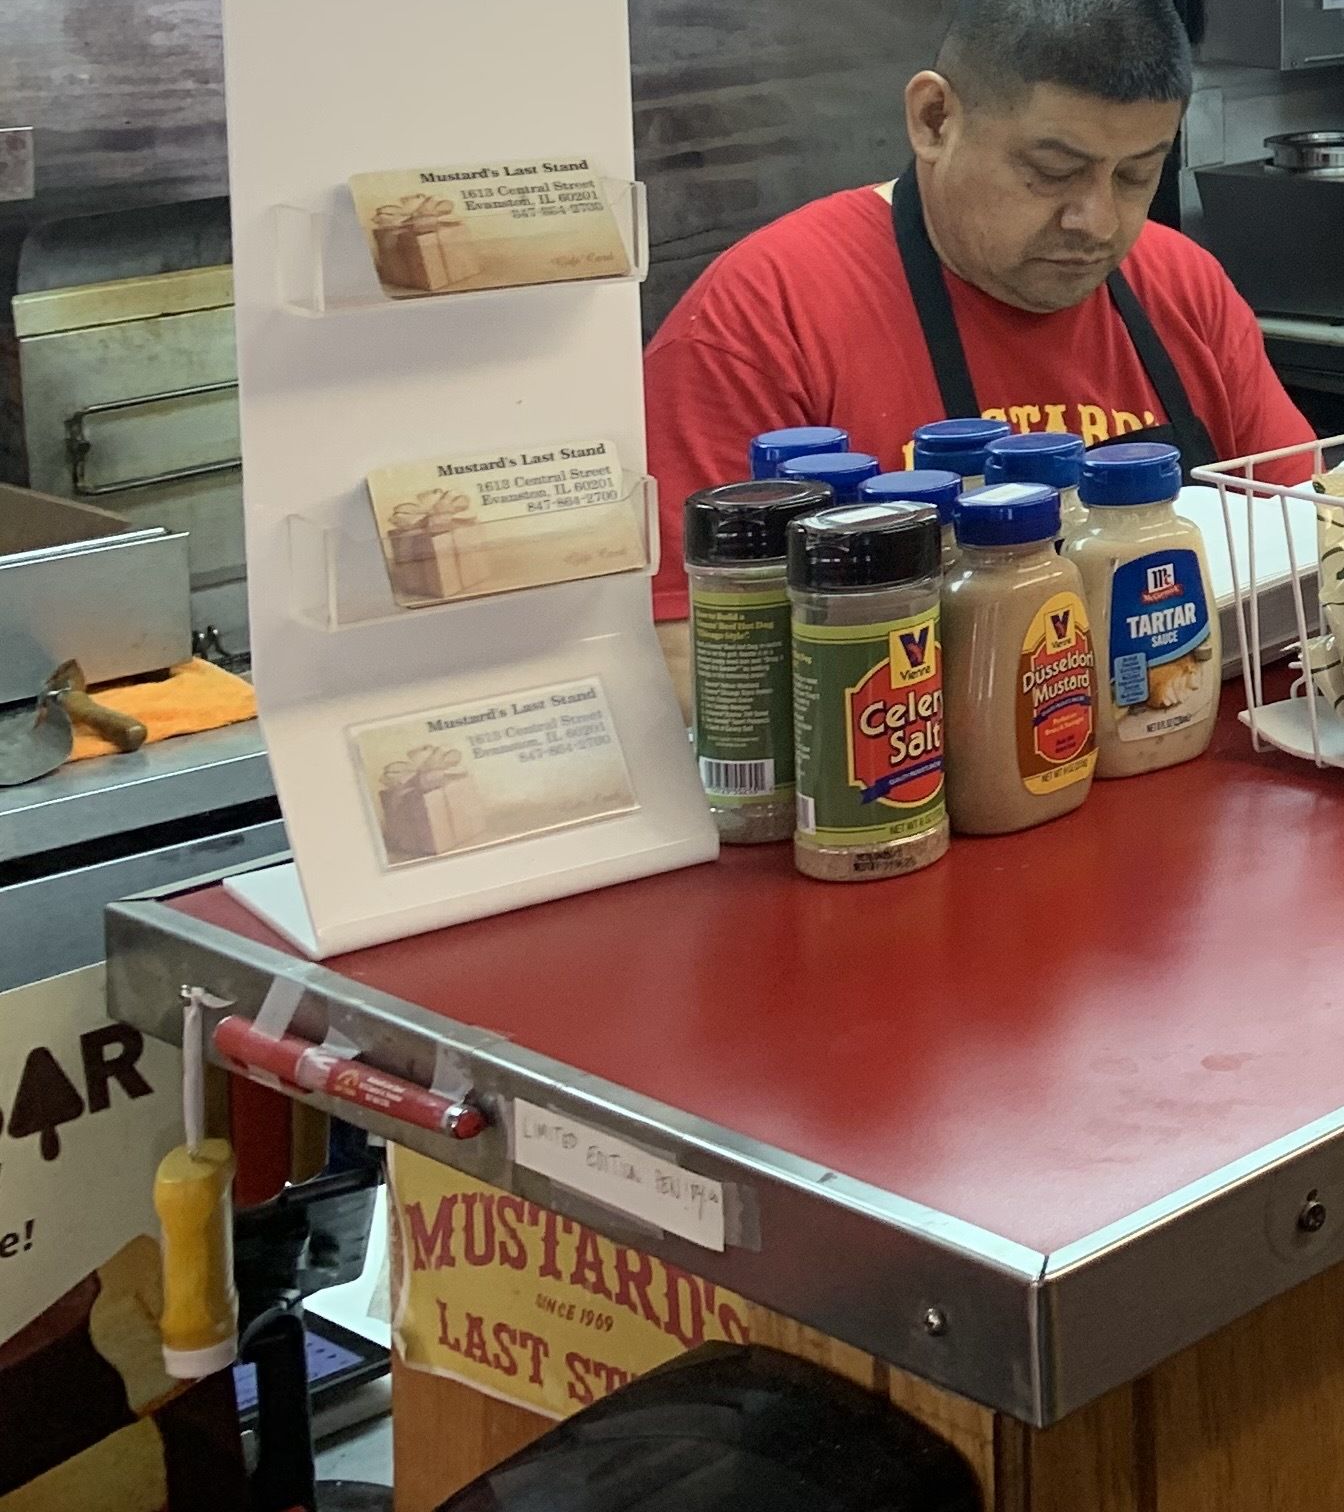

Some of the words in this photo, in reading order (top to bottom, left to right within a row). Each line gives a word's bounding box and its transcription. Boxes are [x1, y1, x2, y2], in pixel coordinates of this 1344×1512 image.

[420, 167, 499, 184] Mustard's
[503, 164, 538, 176] Last
[542, 159, 589, 173] Stand
[497, 182, 550, 196] Central
[553, 179, 596, 191] Street
[437, 456, 517, 477] Mustard's
[520, 450, 555, 466] Last
[560, 443, 606, 460] Stand
[514, 470, 567, 487] Central
[570, 465, 612, 479] Street
[1126, 601, 1197, 640] TARTAR
[1151, 629, 1179, 649] SAUCE
[900, 664, 932, 681] Vienna
[1033, 669, 1090, 709] Mustard
[426, 707, 508, 733] Mustard's
[511, 699, 545, 716] Last
[550, 687, 597, 707] Stand
[889, 720, 941, 765] Salt
[535, 1293, 577, 1322] SINCE
[436, 1297, 550, 1389] LAST
